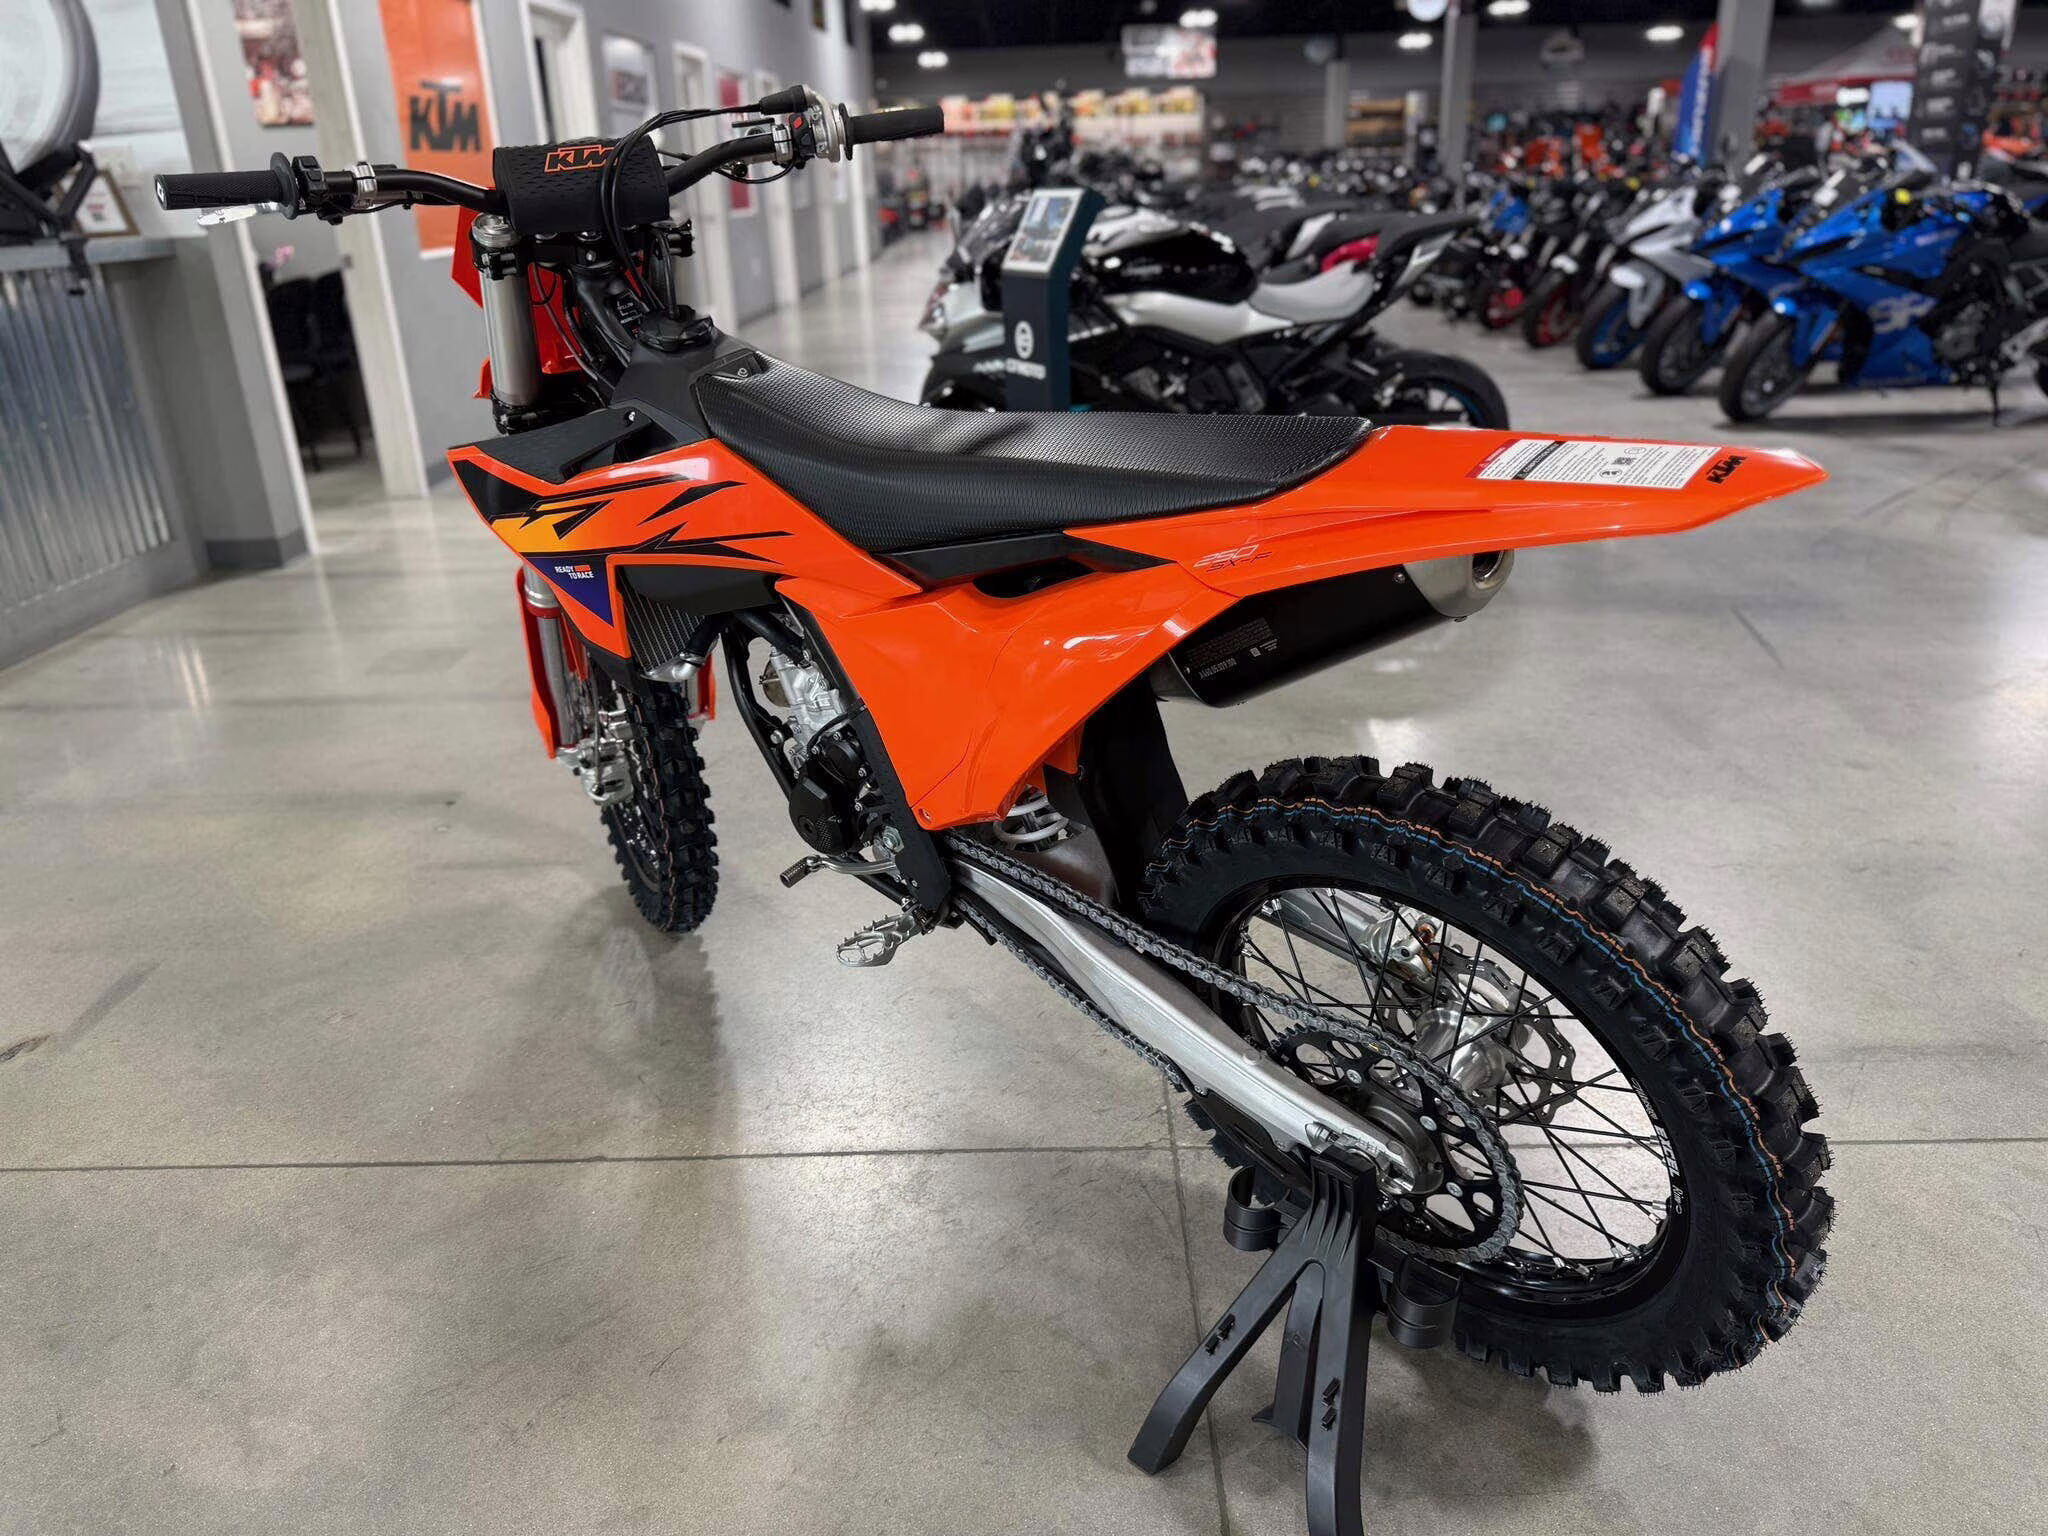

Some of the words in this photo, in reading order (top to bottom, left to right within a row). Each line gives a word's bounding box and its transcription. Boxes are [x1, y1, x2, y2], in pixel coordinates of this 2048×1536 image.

[410, 79, 483, 152] KTM
[1705, 455, 1747, 484] KTM
[1193, 544, 1260, 568] 250
[1206, 552, 1273, 573] SX-F
[554, 565, 575, 573] READY
[568, 572, 578, 580] TO
[577, 571, 595, 579] RACE
[1654, 1124, 1681, 1178] EXCEL
